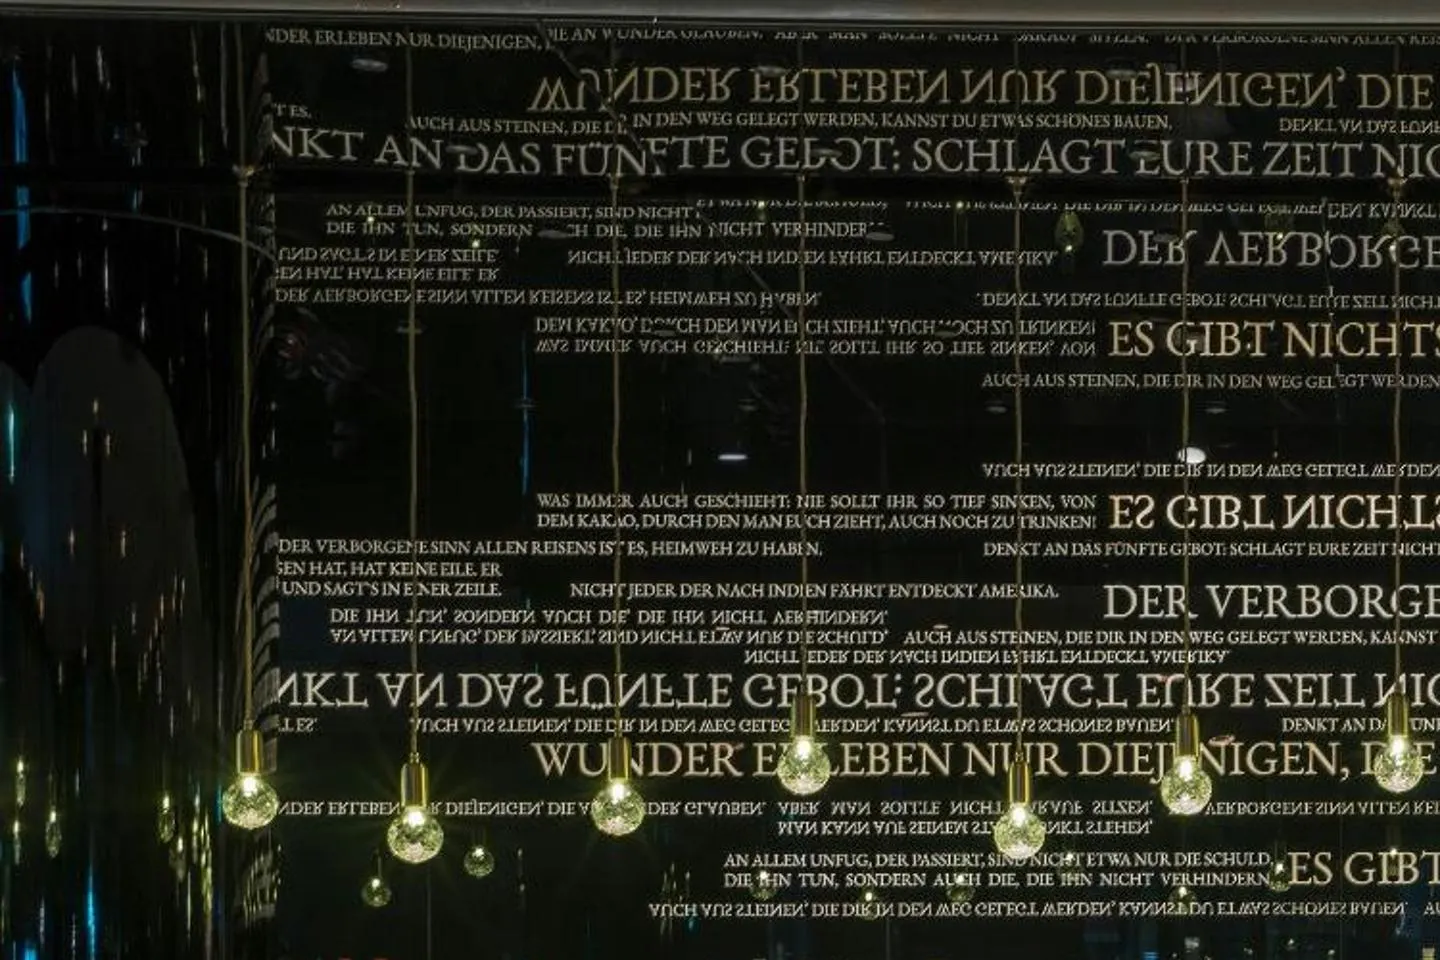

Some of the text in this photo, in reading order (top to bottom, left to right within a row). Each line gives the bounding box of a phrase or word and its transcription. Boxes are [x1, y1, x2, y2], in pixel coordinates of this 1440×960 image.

[374, 133, 444, 169] AN
[913, 136, 1127, 174] SCHLAGT
[1262, 141, 1365, 177] ZEIT
[1109, 321, 1154, 357] ES
[1166, 321, 1276, 357] GIBT
[537, 493, 570, 508] WAS
[639, 493, 689, 508] AUCH
[694, 494, 790, 509] GESCHIEHT:
[797, 494, 825, 509] NIE
[831, 494, 880, 509] SOLLT
[887, 494, 918, 509] IHR
[924, 495, 945, 509] SO
[950, 494, 986, 509] TIEF
[1061, 495, 1097, 509] VON
[538, 513, 574, 528] DEM
[643, 513, 703, 528] DURCH
[706, 514, 740, 528] DEN
[742, 514, 784, 528] MAN
[834, 514, 886, 532] ZIEHT,
[888, 514, 937, 529] AUCH
[940, 514, 989, 529] NOCH
[992, 514, 1015, 529] ZU
[983, 541, 1041, 557] DENKT
[1044, 542, 1068, 556] AN
[1071, 542, 1101, 556] DAS
[1104, 540, 1168, 556] FÜNFTE
[1229, 542, 1306, 557] SCHLAGT
[1308, 542, 1350, 556] EURE
[1352, 541, 1389, 556] ZEIT
[570, 583, 627, 598] NICHT
[627, 583, 675, 600] JEDER
[679, 583, 714, 598] DER
[716, 583, 764, 598] NACH
[830, 581, 887, 598] FÄHRT
[889, 584, 978, 598] ENTDECKT
[1103, 583, 1197, 619] DER
[753, 741, 955, 777] ELEBEN
[1078, 740, 1350, 785] DIEJNIGEN,
[1288, 851, 1333, 886] ES
